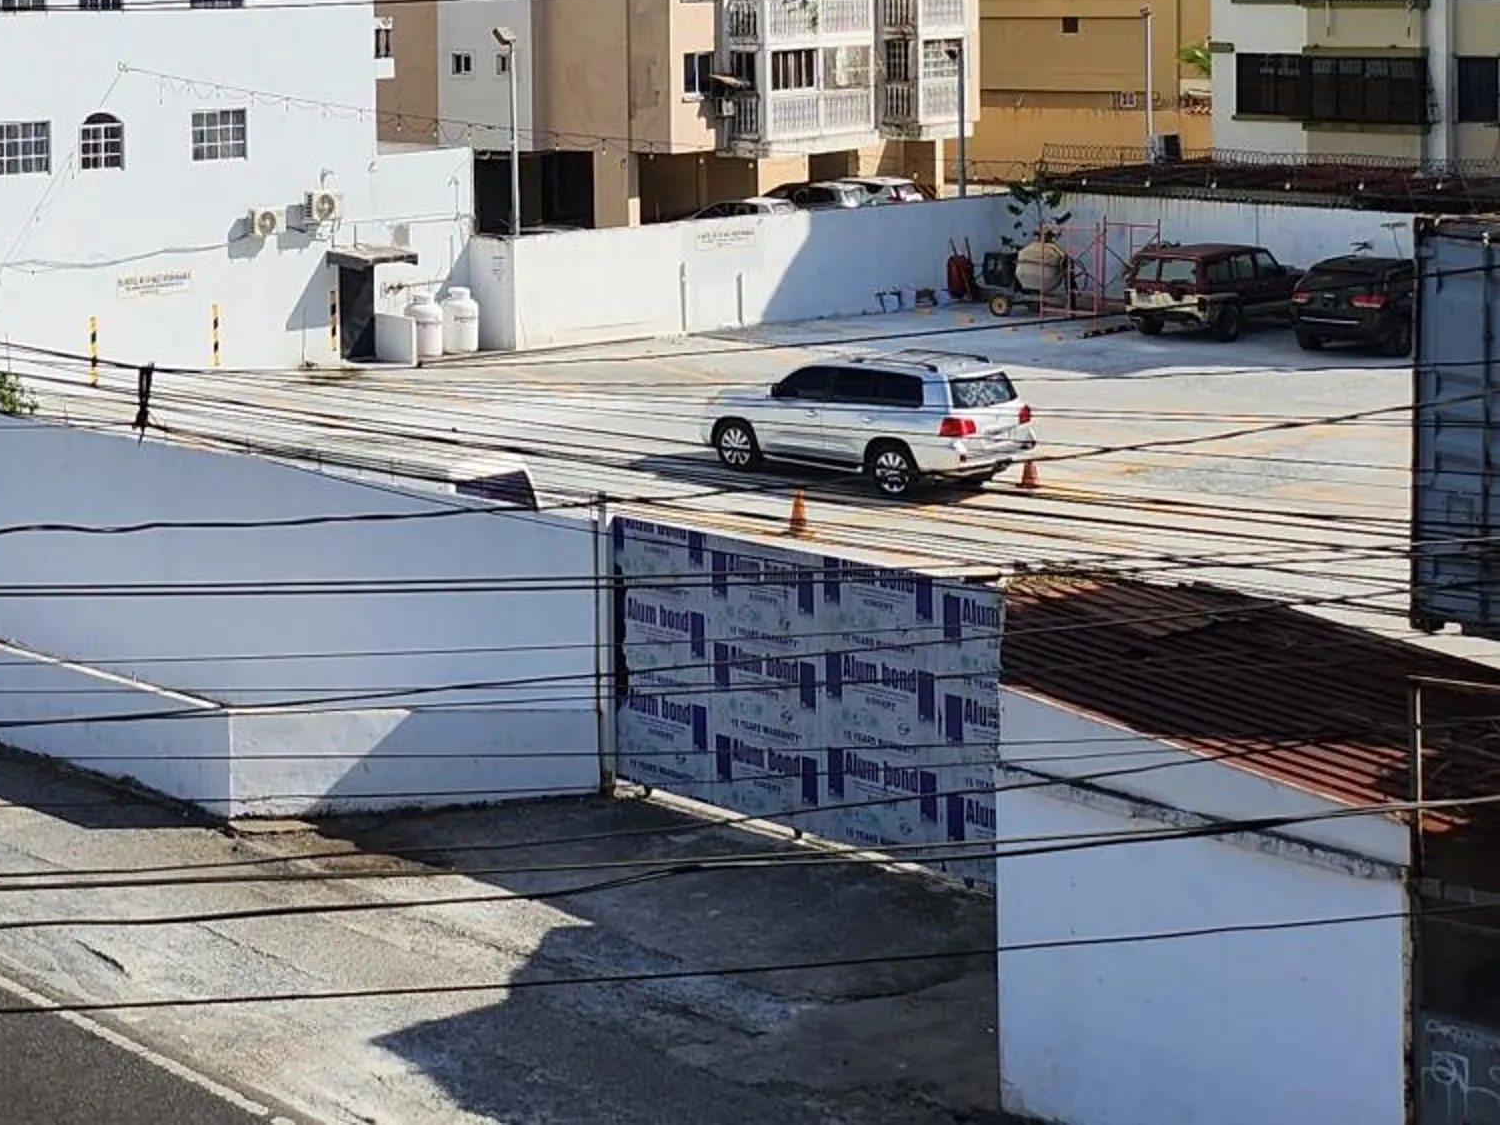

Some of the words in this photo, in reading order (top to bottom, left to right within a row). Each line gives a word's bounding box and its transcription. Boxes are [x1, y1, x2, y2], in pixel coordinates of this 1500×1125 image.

[843, 654, 877, 685] Alum
[881, 662, 917, 694] bond
[661, 694, 691, 726] bond
[845, 751, 879, 784] Alum
